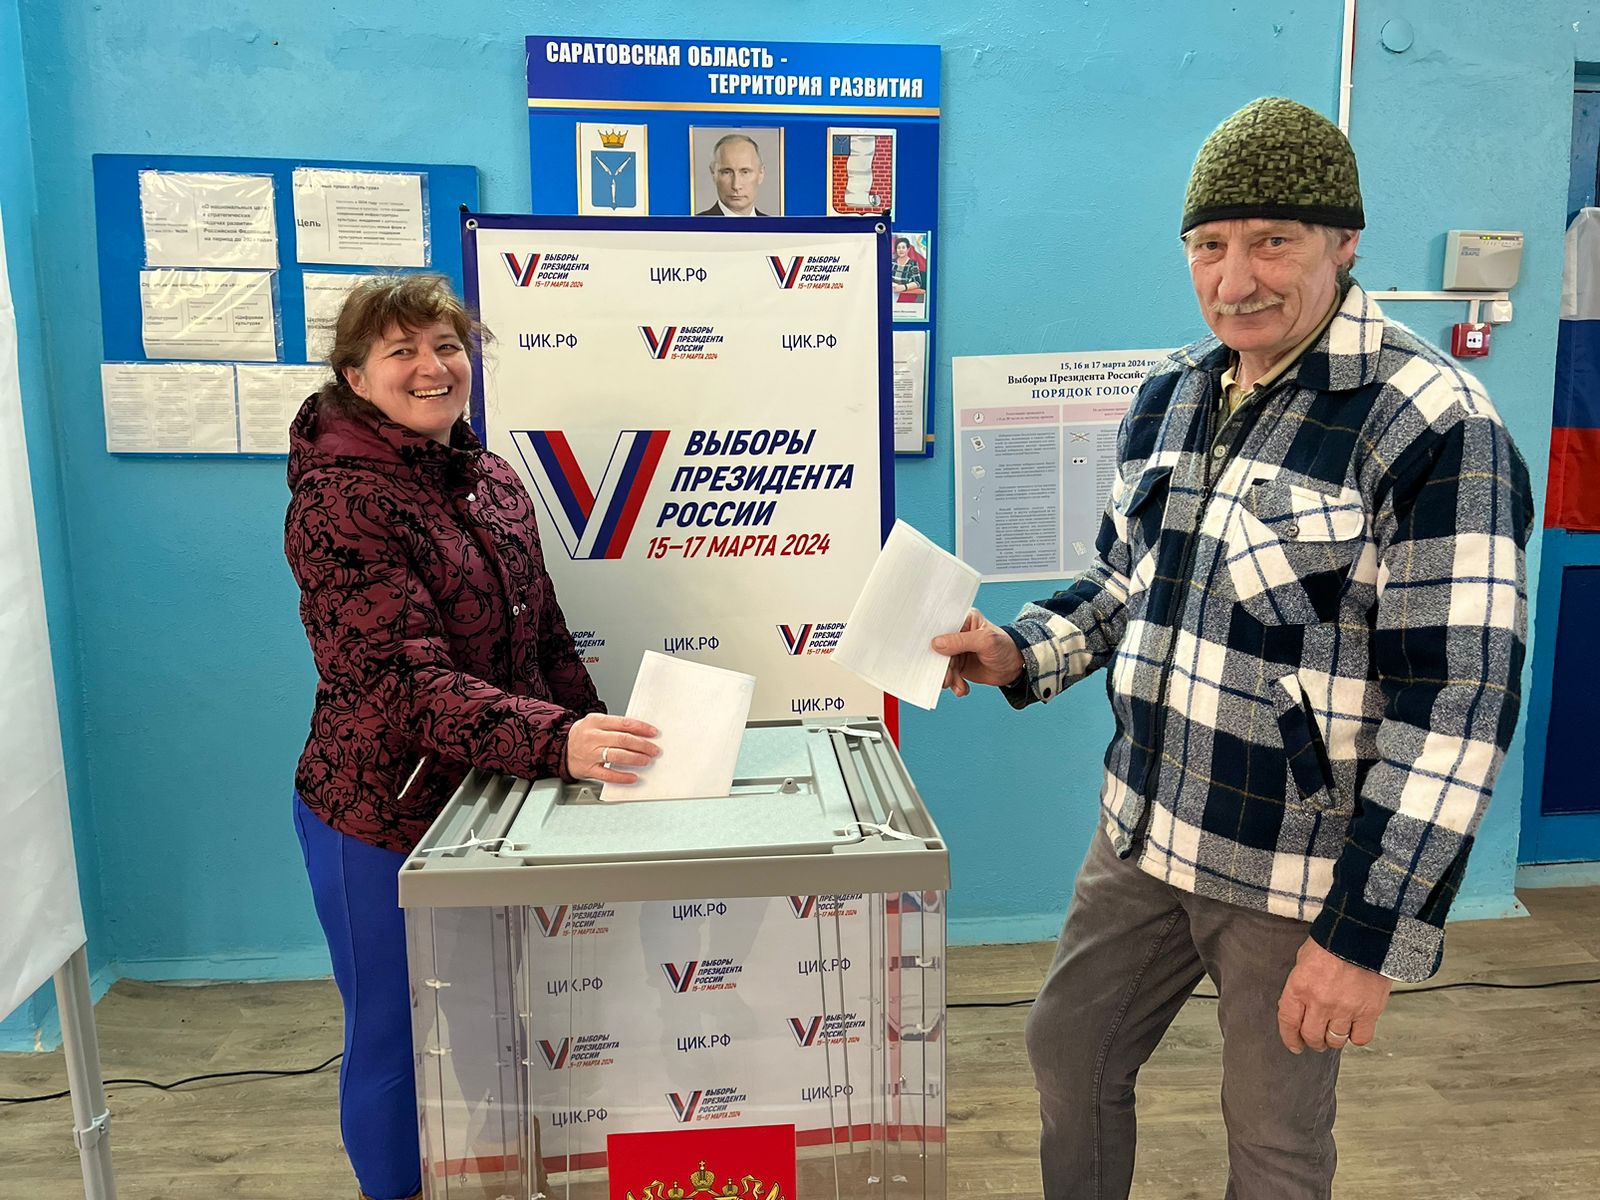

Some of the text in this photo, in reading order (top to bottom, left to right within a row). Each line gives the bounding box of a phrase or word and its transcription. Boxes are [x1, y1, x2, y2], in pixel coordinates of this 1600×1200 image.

[546, 41, 681, 66] САРАТОВСКАЯ
[688, 45, 773, 68] ОБЛАСТЬ
[708, 73, 923, 98] ТЕРРИТОРИЯ РАЗВИТИЯ
[297, 219, 321, 228] Цель
[544, 253, 579, 261] ВЫБОРЫ
[807, 256, 841, 264] ВЫБОРЫ
[540, 263, 590, 272] ПРЕЗИДЕНТА
[803, 265, 850, 273] ПРЕЗИДЕНТА
[537, 272, 569, 280] РОССИИ
[650, 267, 707, 285] ЦИК.РФ
[800, 274, 830, 282] РОССИИ
[680, 326, 714, 334] ВЫБОРЫ
[519, 333, 578, 350] ЦИК.РФ
[676, 336, 724, 344] ПРЕЗИДЕНТА
[781, 334, 837, 351] ЦИК.РФ
[1060, 362, 1072, 371] 15,
[1073, 362, 1083, 370] 16
[1092, 361, 1101, 369] 17
[1102, 362, 1126, 370] марта
[1127, 359, 1146, 368] 2024
[1008, 370, 1146, 386] Выборы Президента Российс
[1031, 384, 1139, 399] ПОРЯДОК ГОЛОС
[684, 429, 817, 456] ВЫБОРЫ
[670, 463, 855, 495] ПРЕЗИДЕНТА
[656, 500, 777, 528] РОССИИ
[706, 534, 778, 558] МАРТА
[780, 533, 831, 556] 2024
[812, 631, 844, 640] ПРЕЗИД
[664, 636, 719, 654] ЦИК.РФ
[809, 640, 839, 648] РОССИИ
[791, 697, 845, 714] ЦИК.РФ
[673, 902, 727, 920] ЦИК.РФ
[576, 928, 596, 936] МАРТА
[701, 958, 734, 967] ВЫБОРЫ
[798, 958, 851, 976] ЦИК.РФ
[698, 966, 743, 976] ПРЕЗИДЕНТА
[694, 976, 724, 984] РОССИИ
[723, 982, 737, 990] 2024
[576, 1034, 610, 1043] ВЫБОРЫ
[677, 1034, 731, 1053] ЦИК.РФ
[573, 1042, 620, 1052] ПРЕЗИДЕНТА
[570, 1052, 600, 1060] РОССИИ
[705, 1087, 738, 1096] ВЫБОРЫ
[701, 1095, 747, 1105] ПРЕЗИДЕНТА
[698, 1105, 728, 1113] РОССИИ
[552, 1108, 608, 1128] ЦИК.РФ
[710, 1112, 728, 1120] МАРТА
